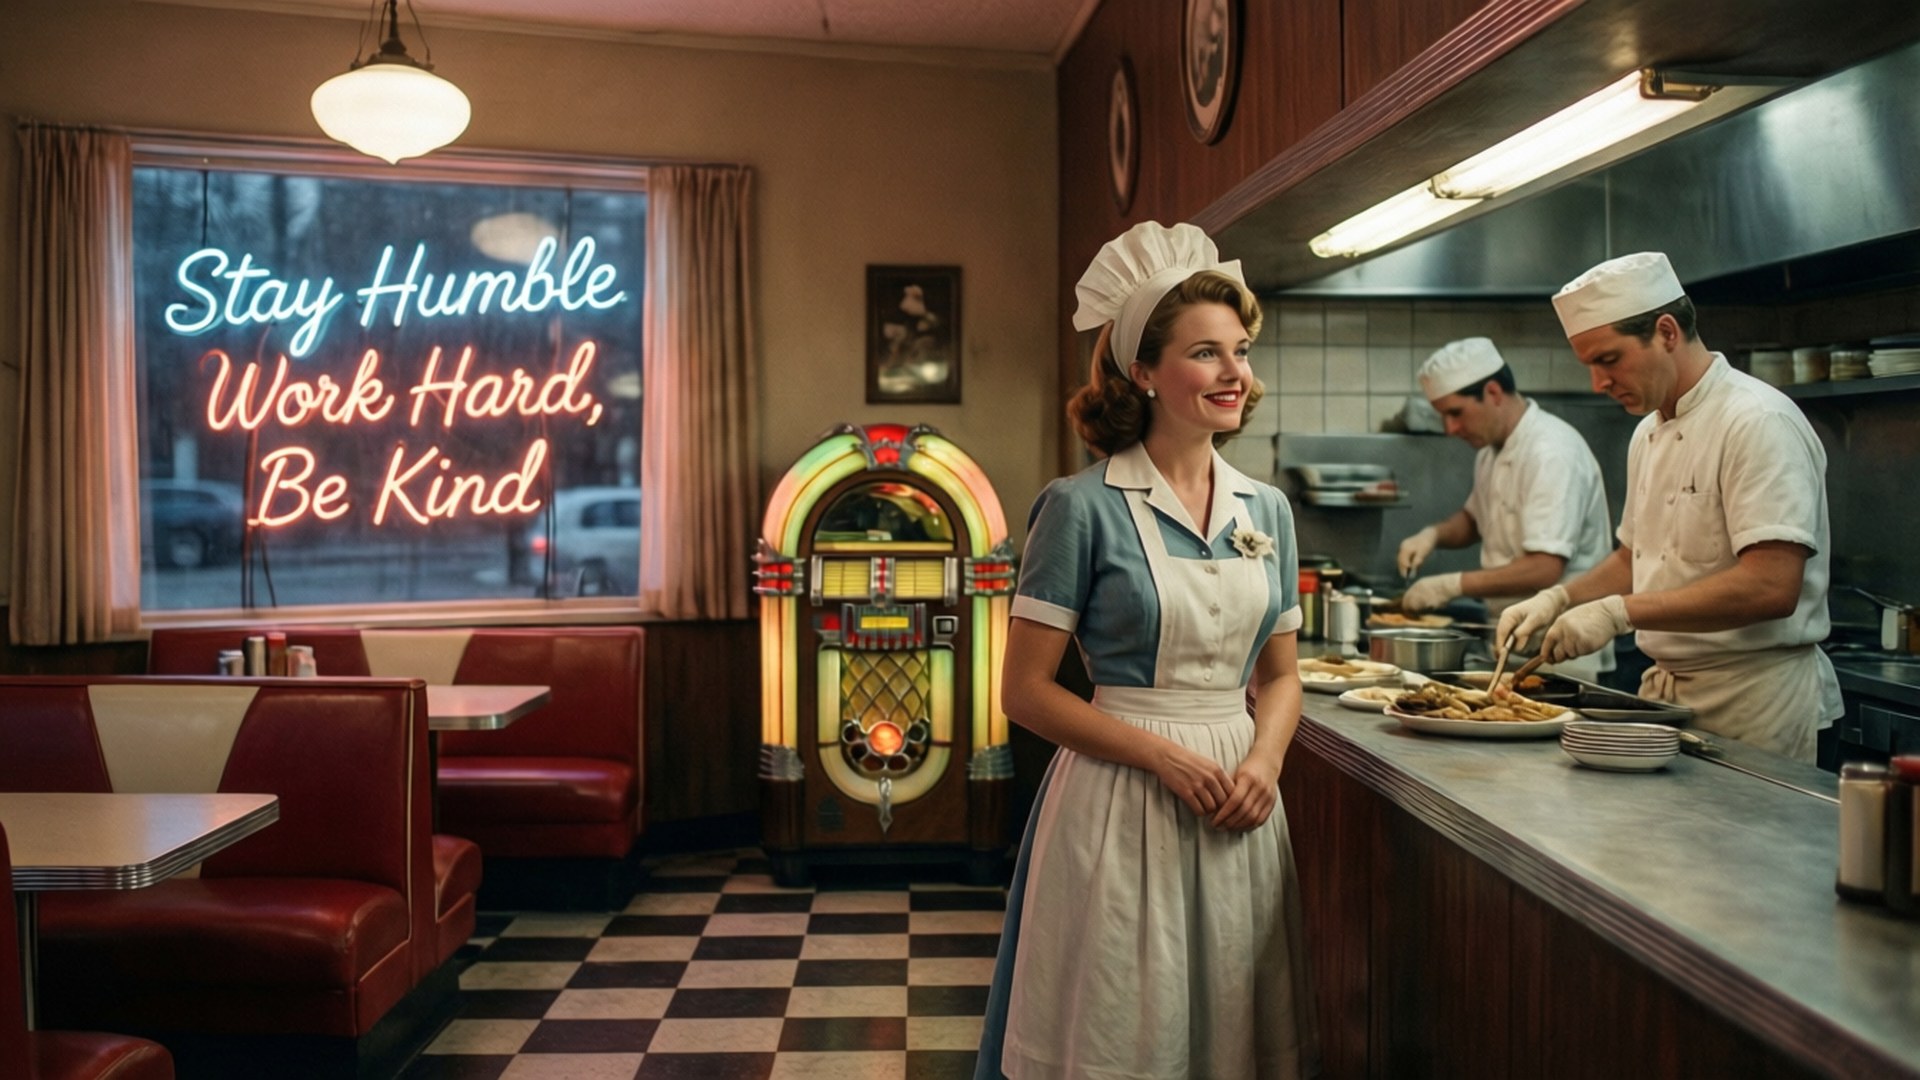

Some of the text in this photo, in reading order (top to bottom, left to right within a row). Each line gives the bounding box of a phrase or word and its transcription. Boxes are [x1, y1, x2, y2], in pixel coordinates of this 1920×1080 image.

[165, 236, 624, 357] Stay Humble
[203, 341, 603, 431] Work Hard,
[247, 438, 547, 526] Be Kind
